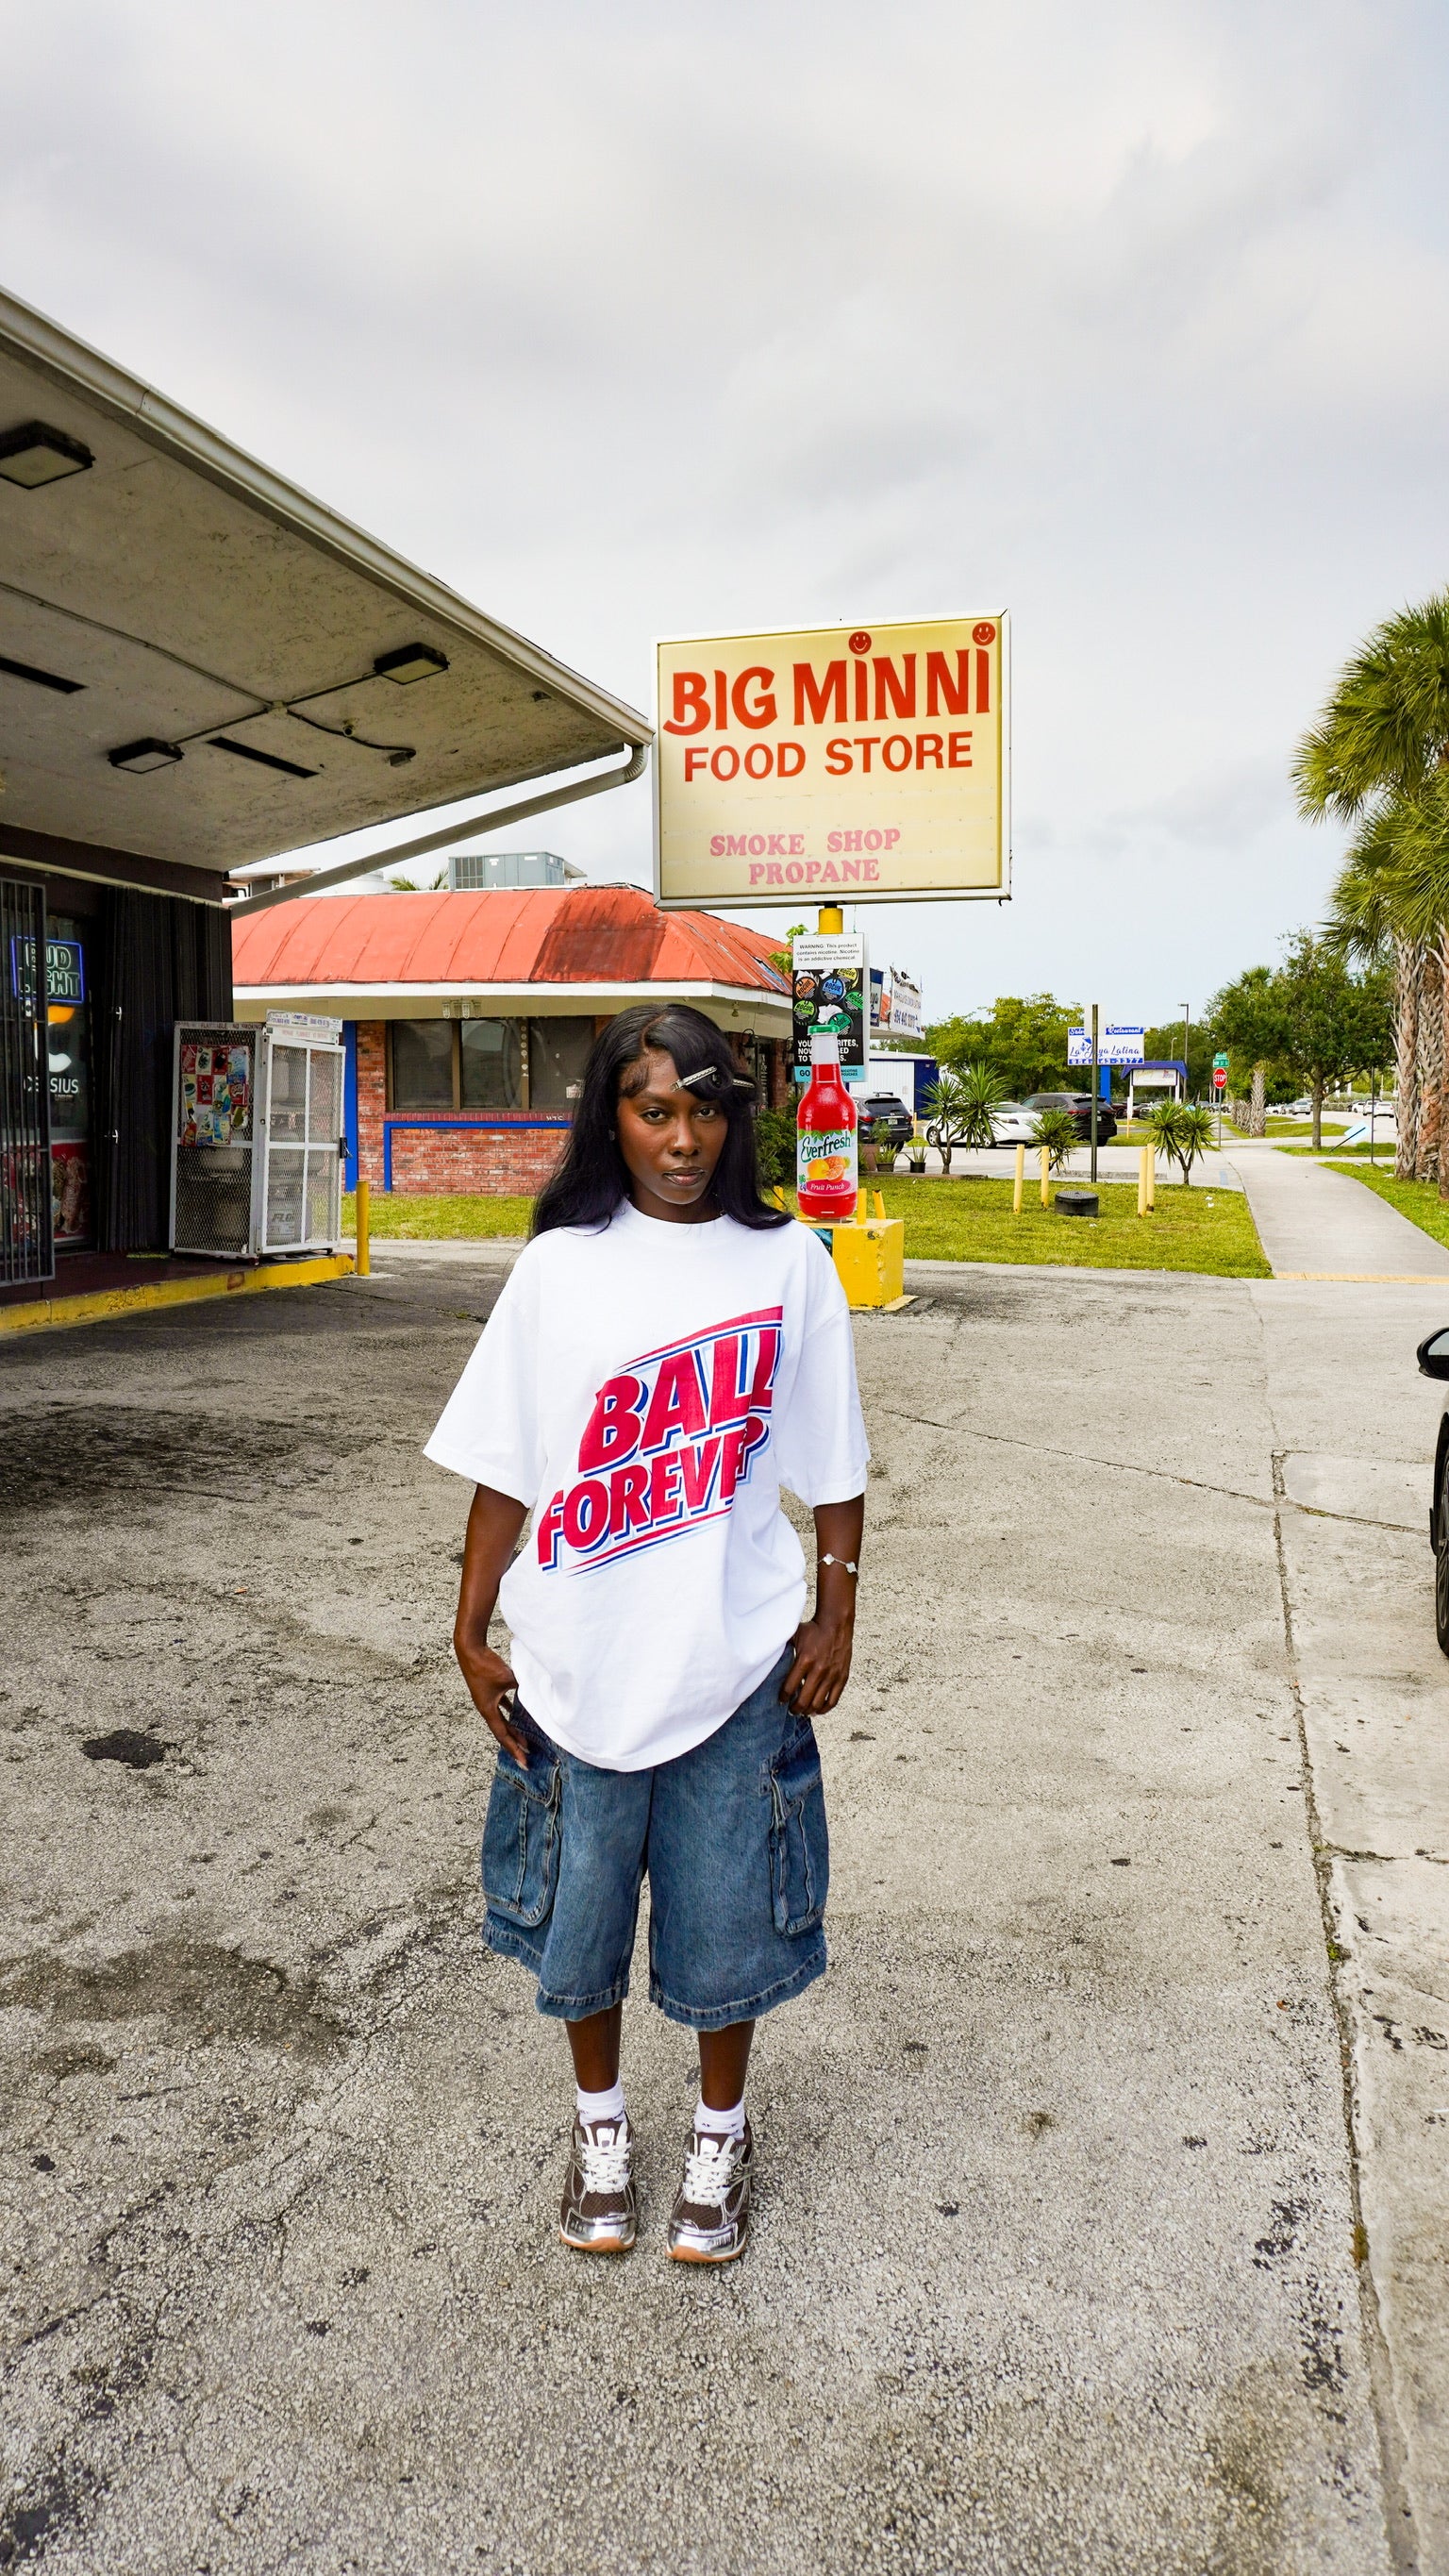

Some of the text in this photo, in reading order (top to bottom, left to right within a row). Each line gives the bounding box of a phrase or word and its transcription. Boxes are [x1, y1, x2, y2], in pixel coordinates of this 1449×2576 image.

[662, 666, 778, 736] BIG
[685, 731, 973, 782] FOOD STORE
[709, 828, 901, 857] SMOKE SHOP
[748, 859, 880, 885] PROPANE
[824, 981, 842, 993] ROGUE
[1069, 1045, 1140, 1060] La Jya Latina
[1214, 1074, 1226, 1082] STOP
[801, 1130, 851, 1163] Everfresh
[825, 1182, 845, 1191] Punch
[577, 1329, 785, 1478] BALL
